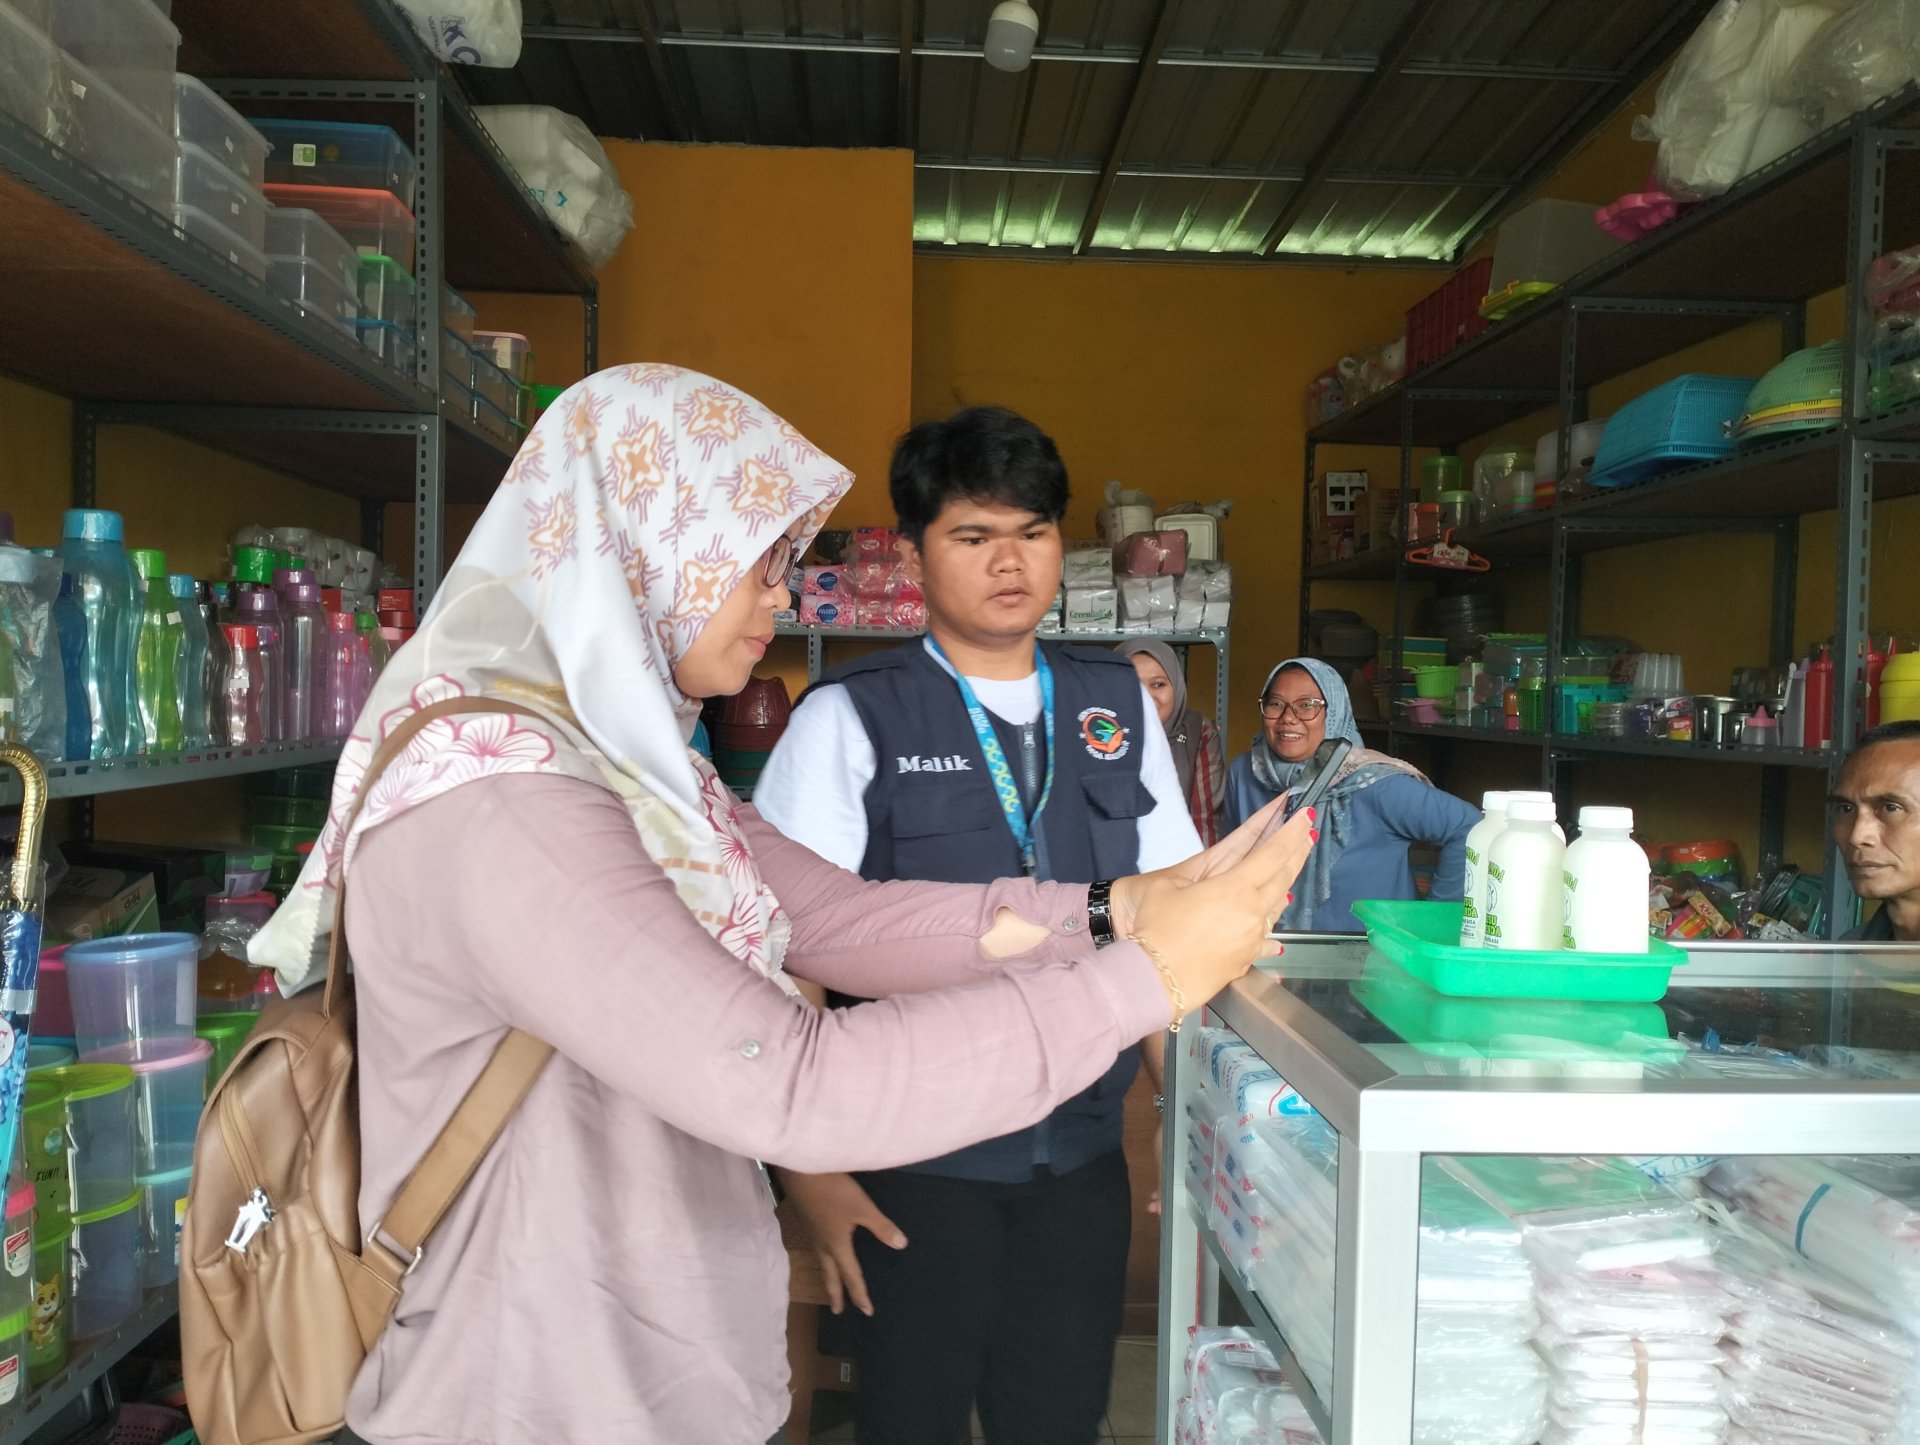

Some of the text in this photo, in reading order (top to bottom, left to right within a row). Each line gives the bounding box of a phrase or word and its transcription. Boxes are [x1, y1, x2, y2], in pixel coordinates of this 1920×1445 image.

[817, 575, 837, 585] PASEO
[817, 607, 838, 616] PASEO
[896, 754, 974, 774] Malik
